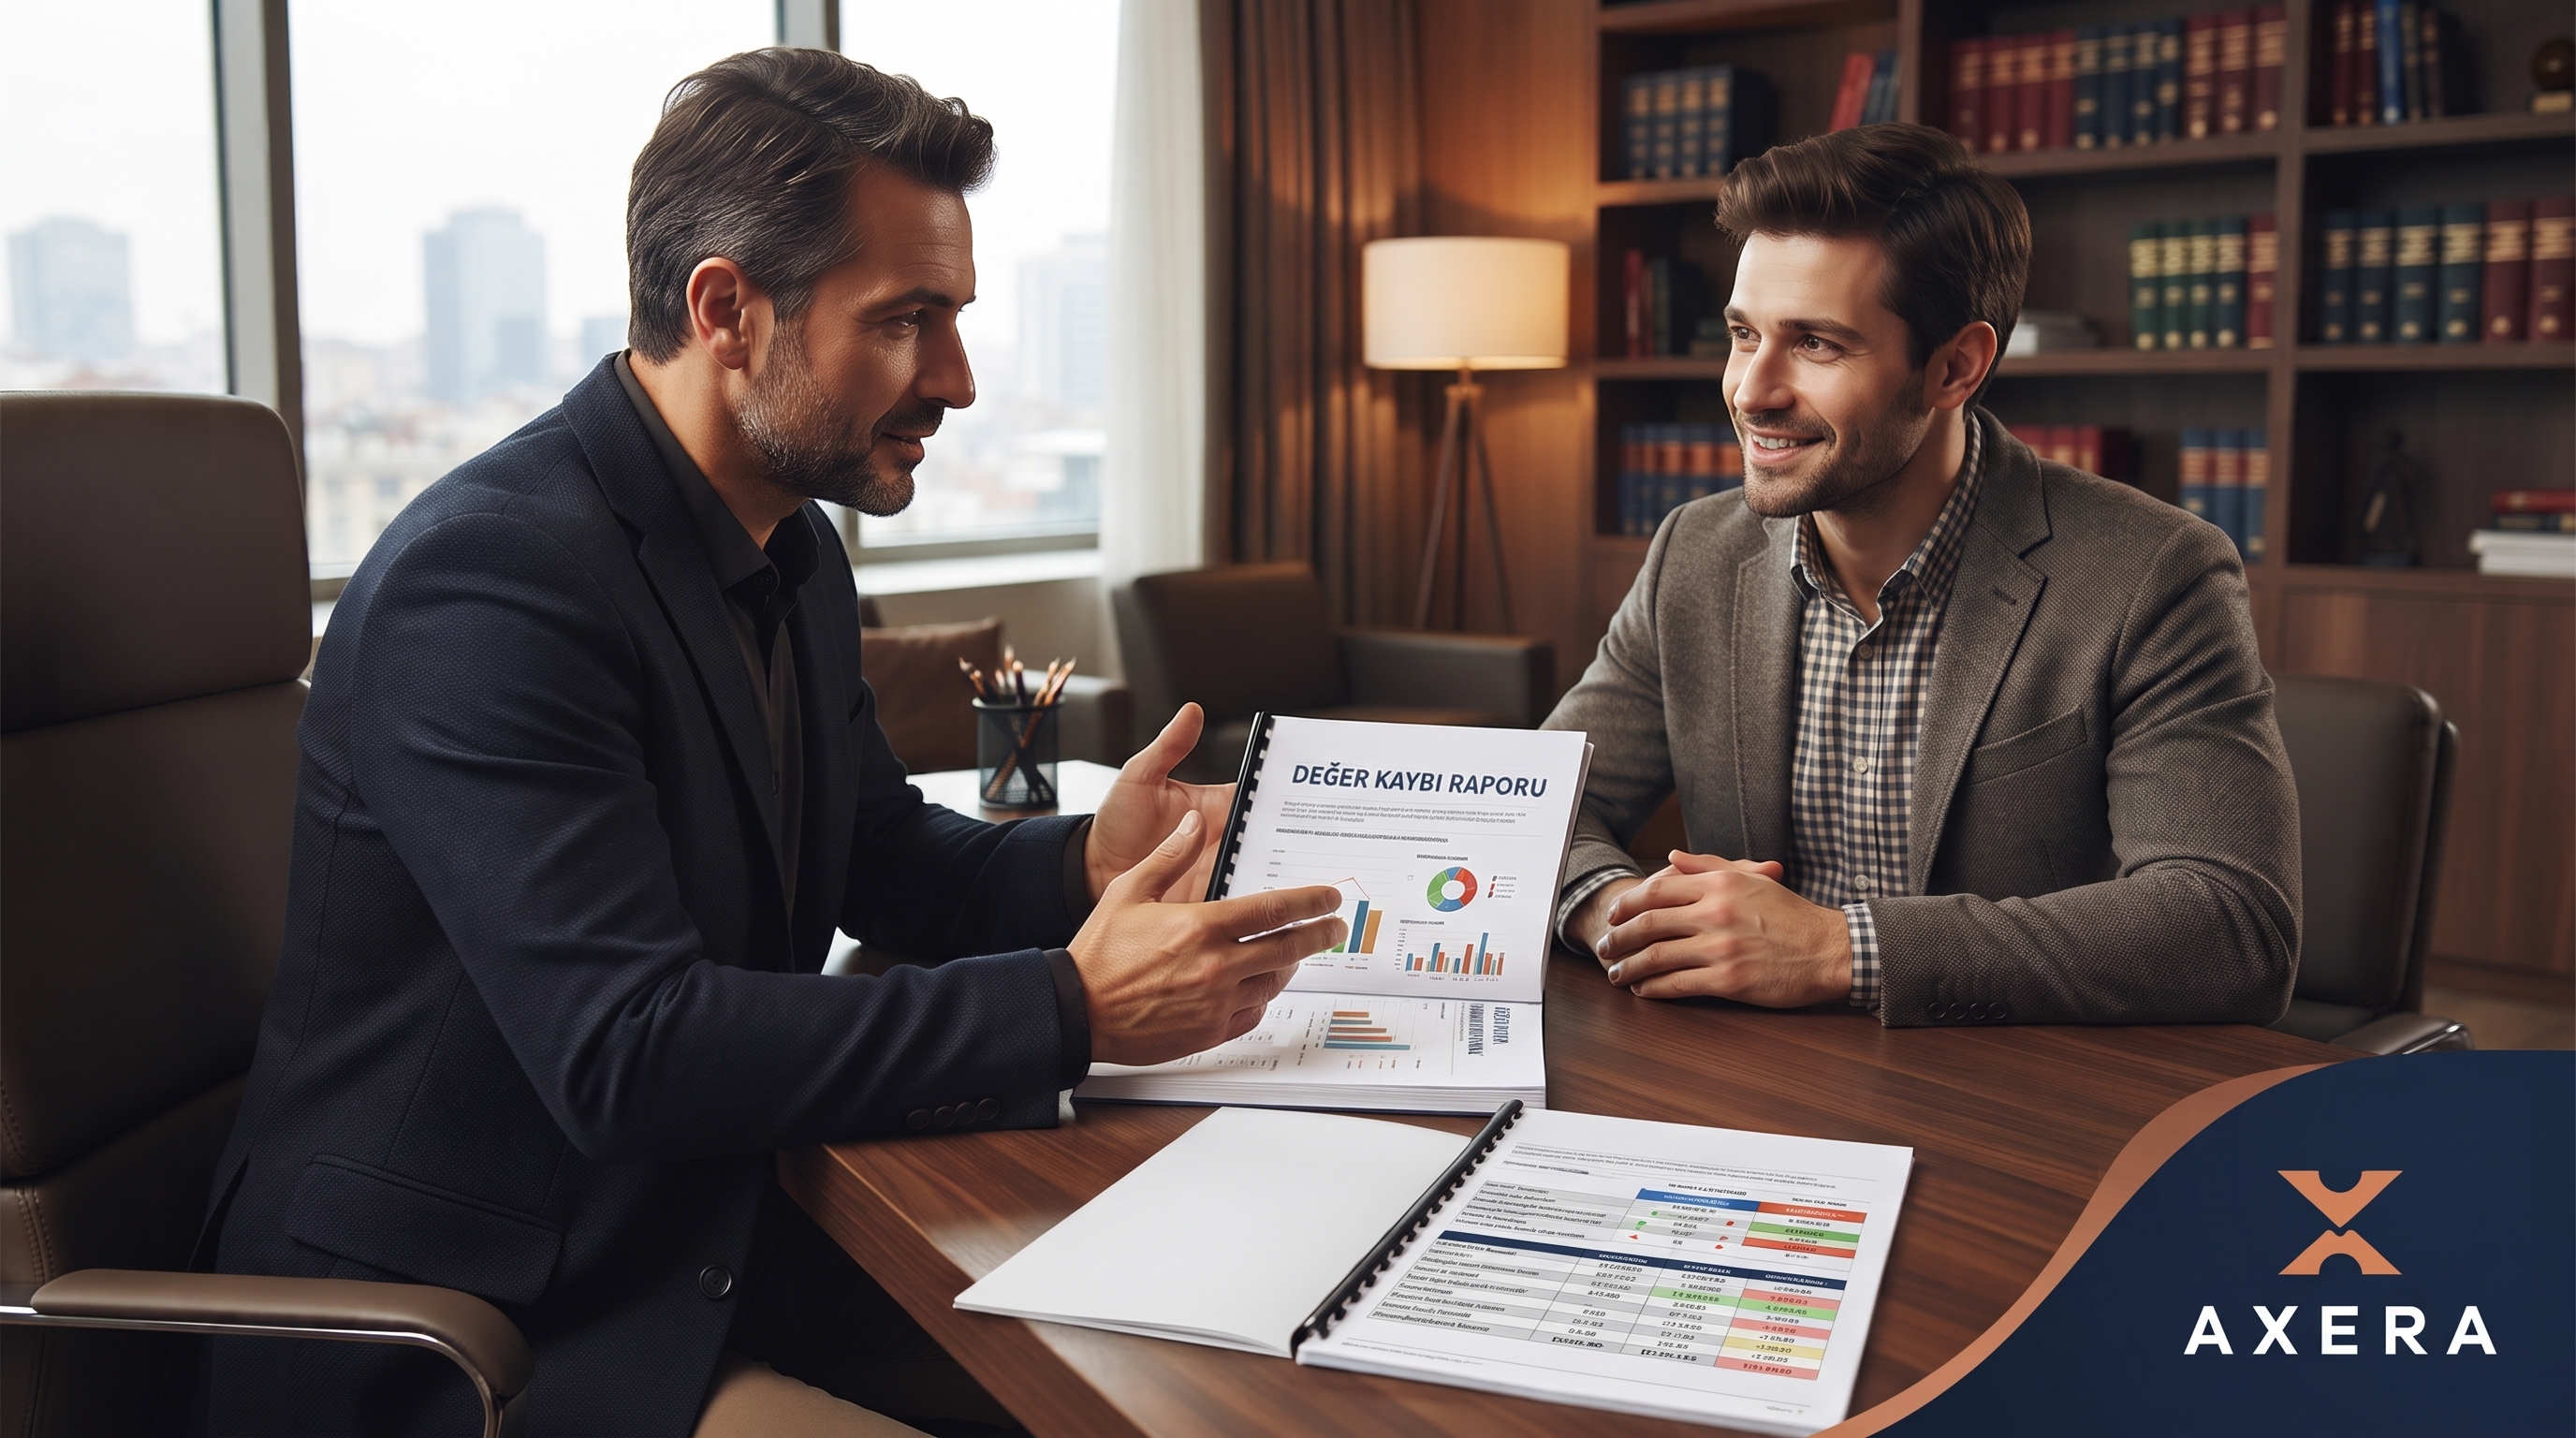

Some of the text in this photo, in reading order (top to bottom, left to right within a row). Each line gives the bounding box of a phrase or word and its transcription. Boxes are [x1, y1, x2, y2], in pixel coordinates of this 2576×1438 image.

[1292, 762, 1547, 798] DEĞER KAYBI RAPORU
